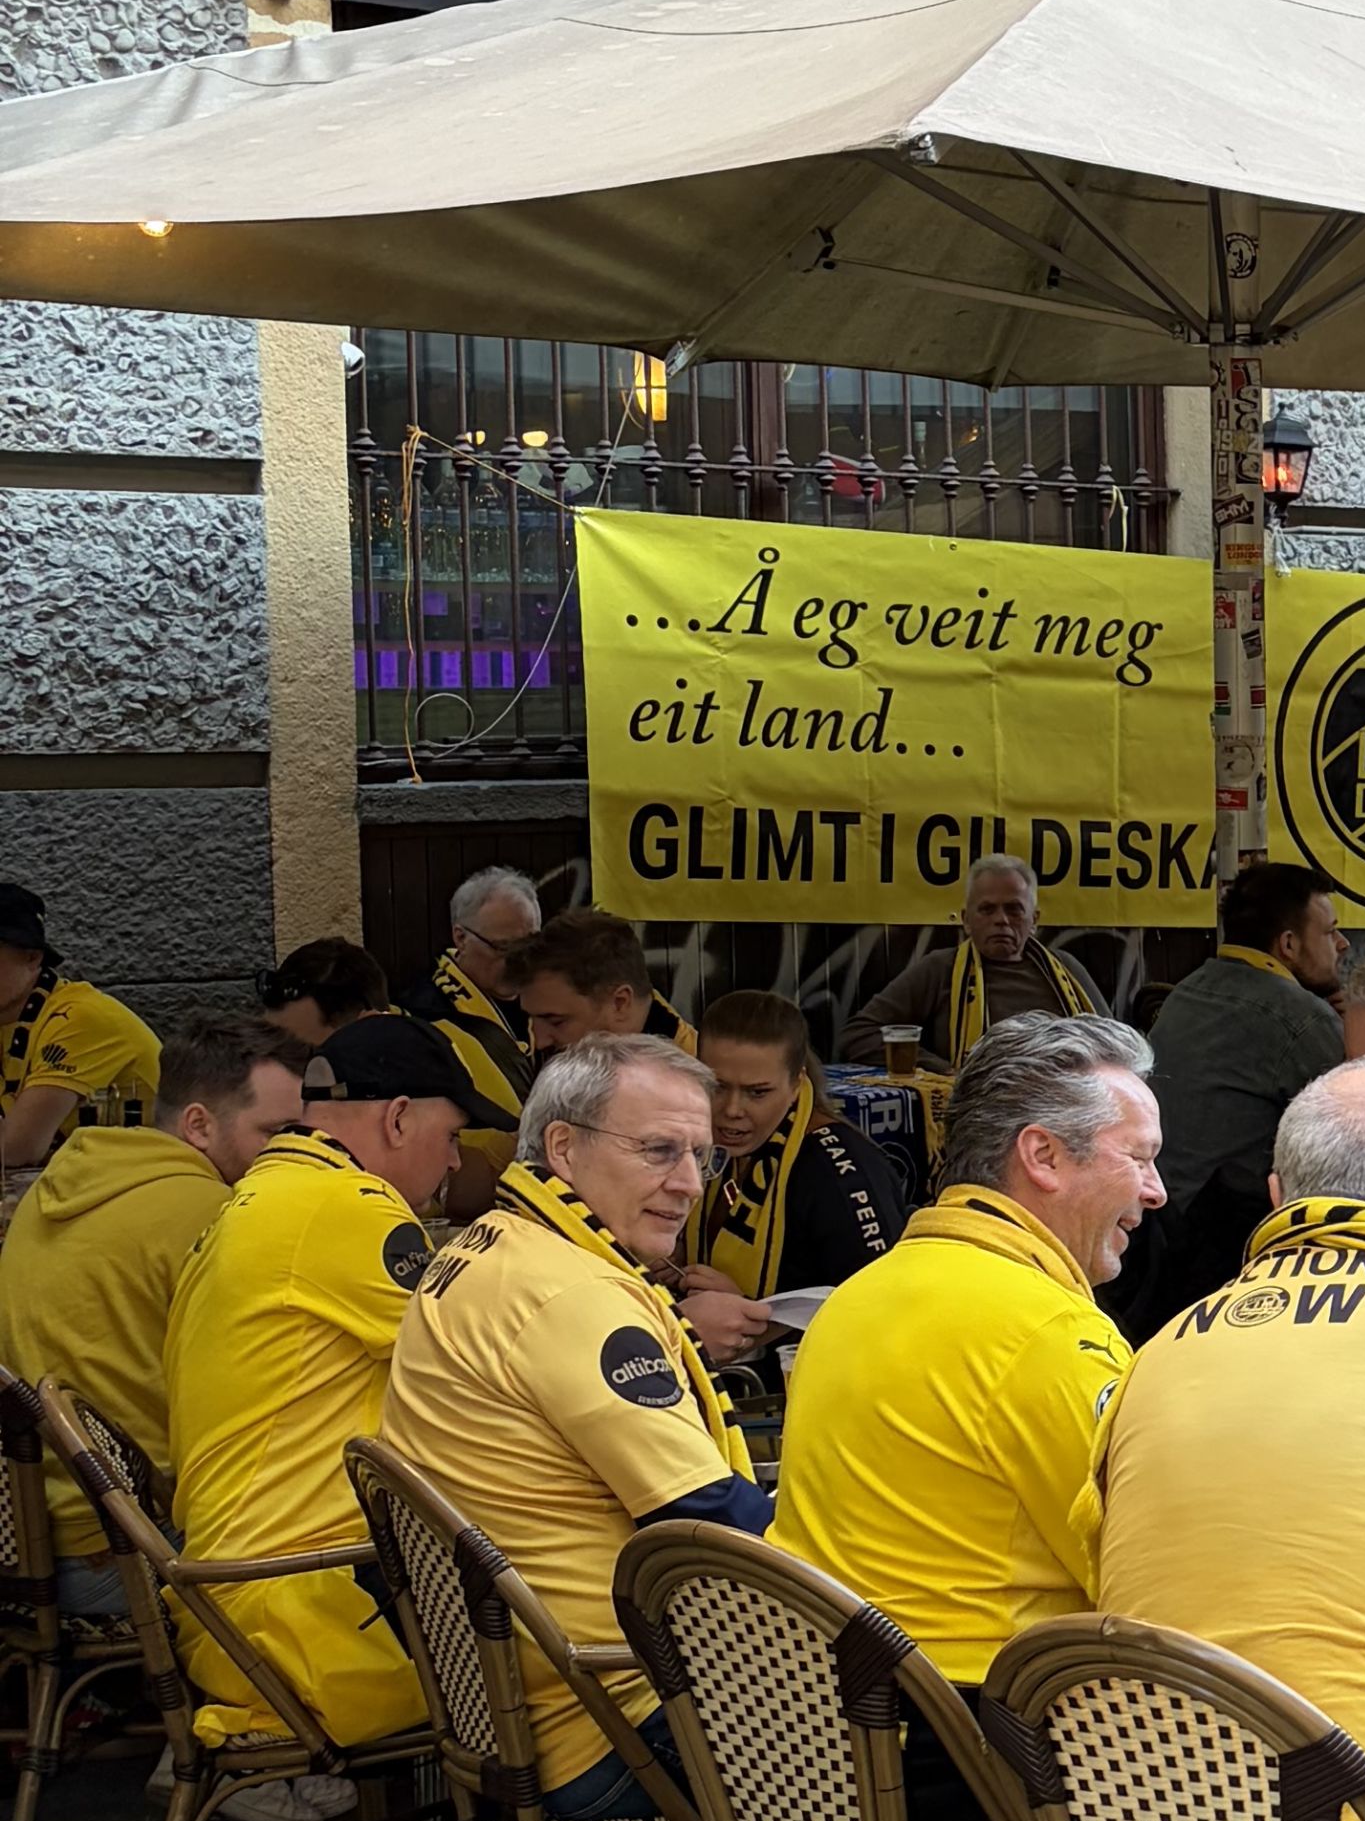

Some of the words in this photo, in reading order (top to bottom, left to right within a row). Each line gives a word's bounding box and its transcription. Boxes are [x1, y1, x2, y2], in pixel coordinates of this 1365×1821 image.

[793, 597, 868, 669] eg
[885, 587, 1018, 652] veit
[1034, 609, 1163, 688] meg
[629, 678, 720, 745] eit
[737, 679, 965, 759] land...
[628, 803, 864, 884] GLIMT
[879, 813, 896, 884] I
[813, 1126, 857, 1176] PEAK
[850, 1189, 887, 1252] PERF
